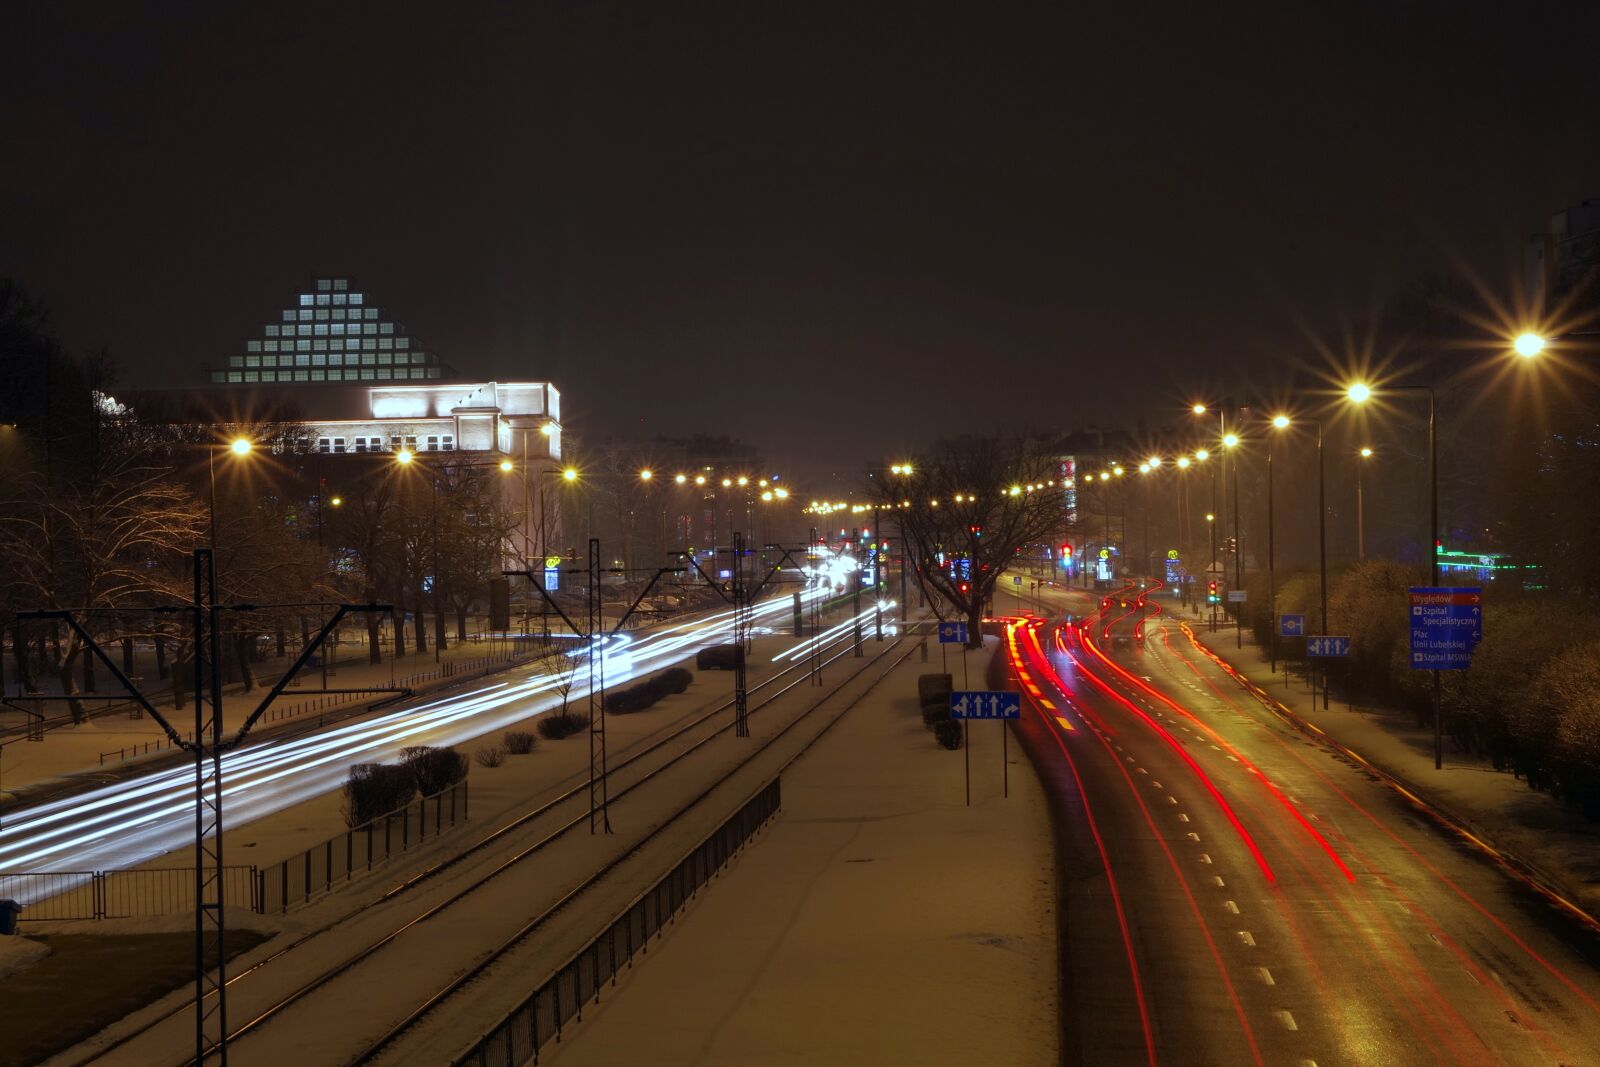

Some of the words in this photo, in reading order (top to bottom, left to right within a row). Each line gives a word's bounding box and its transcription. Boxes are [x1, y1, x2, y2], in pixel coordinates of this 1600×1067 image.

[1413, 594, 1450, 605] Wyględów
[1423, 607, 1447, 616] Szpital
[1423, 617, 1477, 627] Specjalistyczny
[1414, 630, 1428, 638] Plac
[1414, 640, 1428, 648] Unii
[1429, 640, 1466, 650] Lubelskiej
[1423, 652, 1445, 662] Szpital
